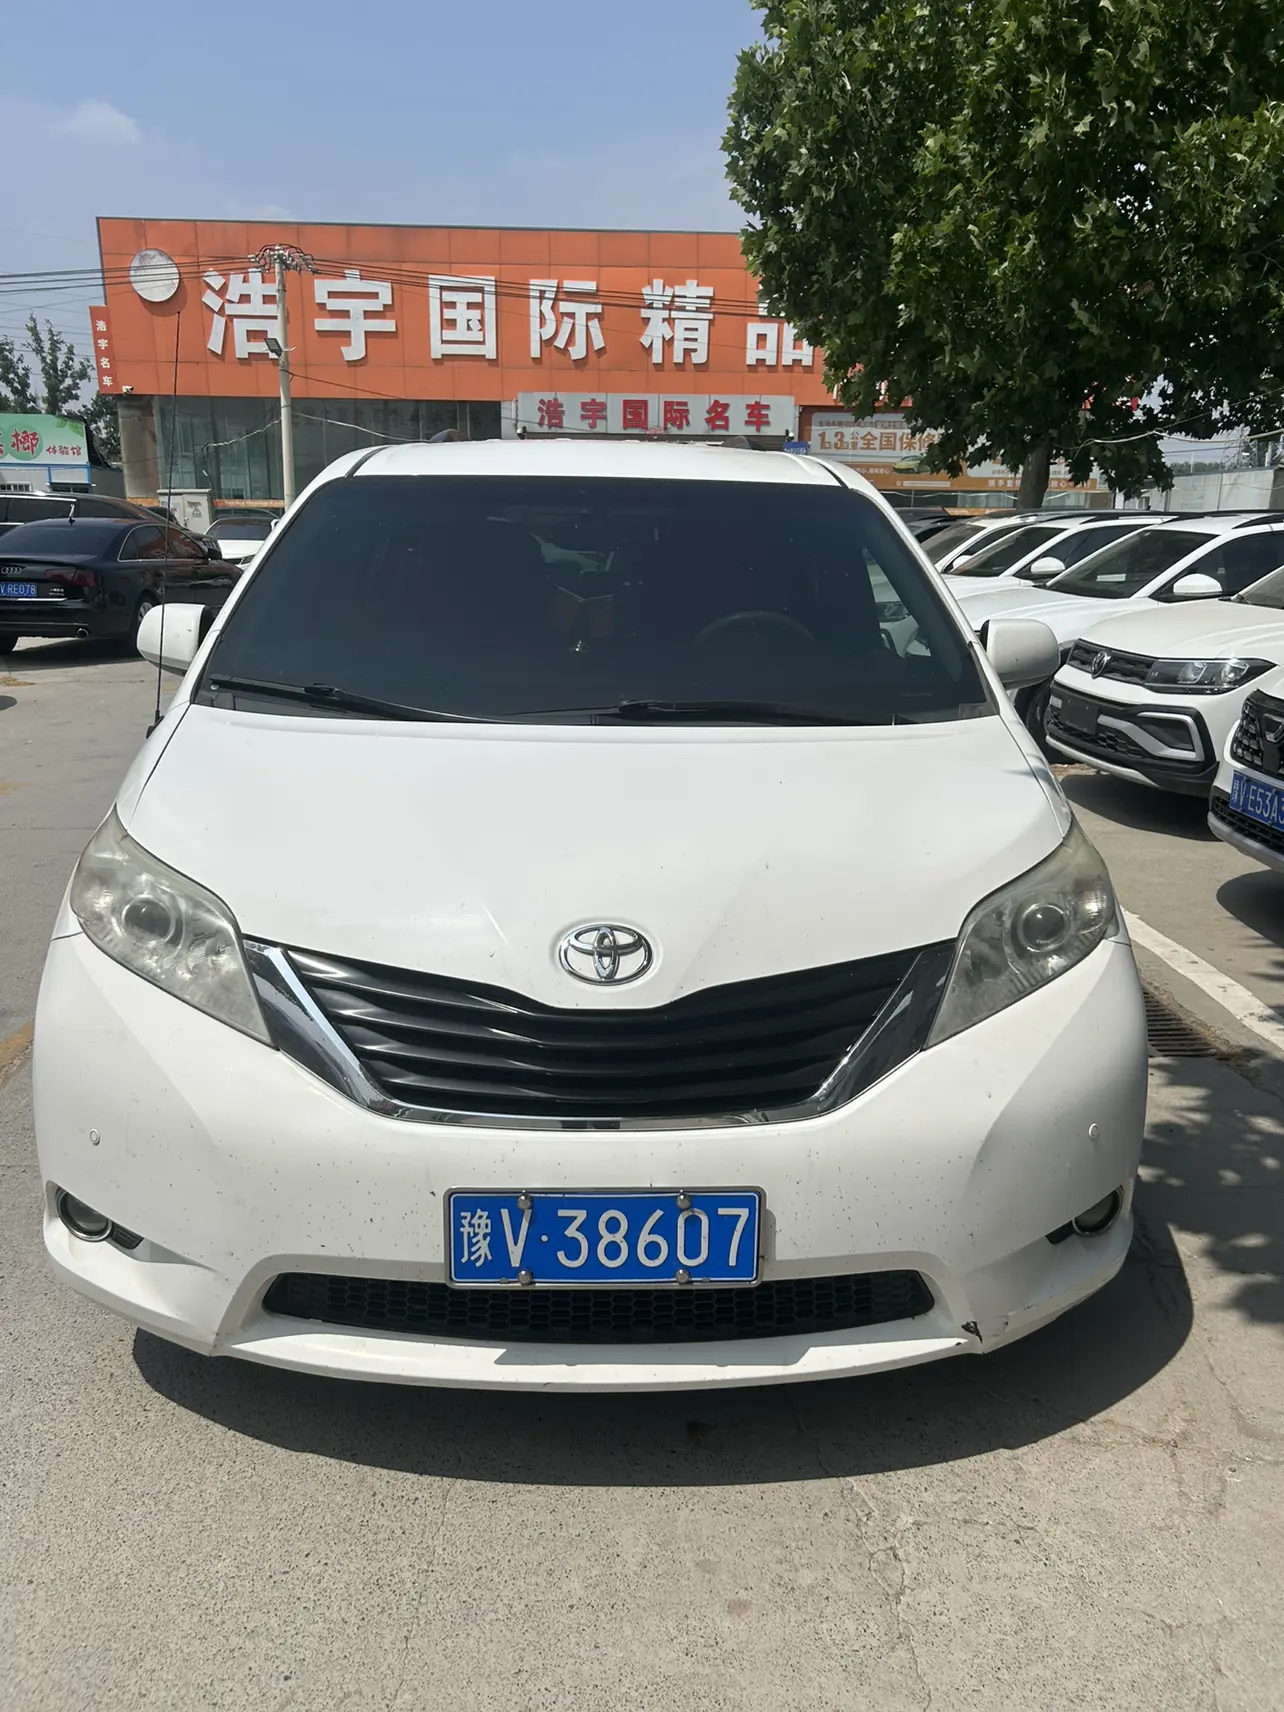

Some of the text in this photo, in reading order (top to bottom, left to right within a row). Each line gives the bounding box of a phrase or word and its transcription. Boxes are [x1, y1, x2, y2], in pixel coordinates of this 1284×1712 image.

[95, 320, 113, 387] 浩宇名车
[537, 397, 772, 432] 浩宇国际名车
[0, 428, 39, 456] 榔
[459, 1207, 750, 1268] 豫V·38607
